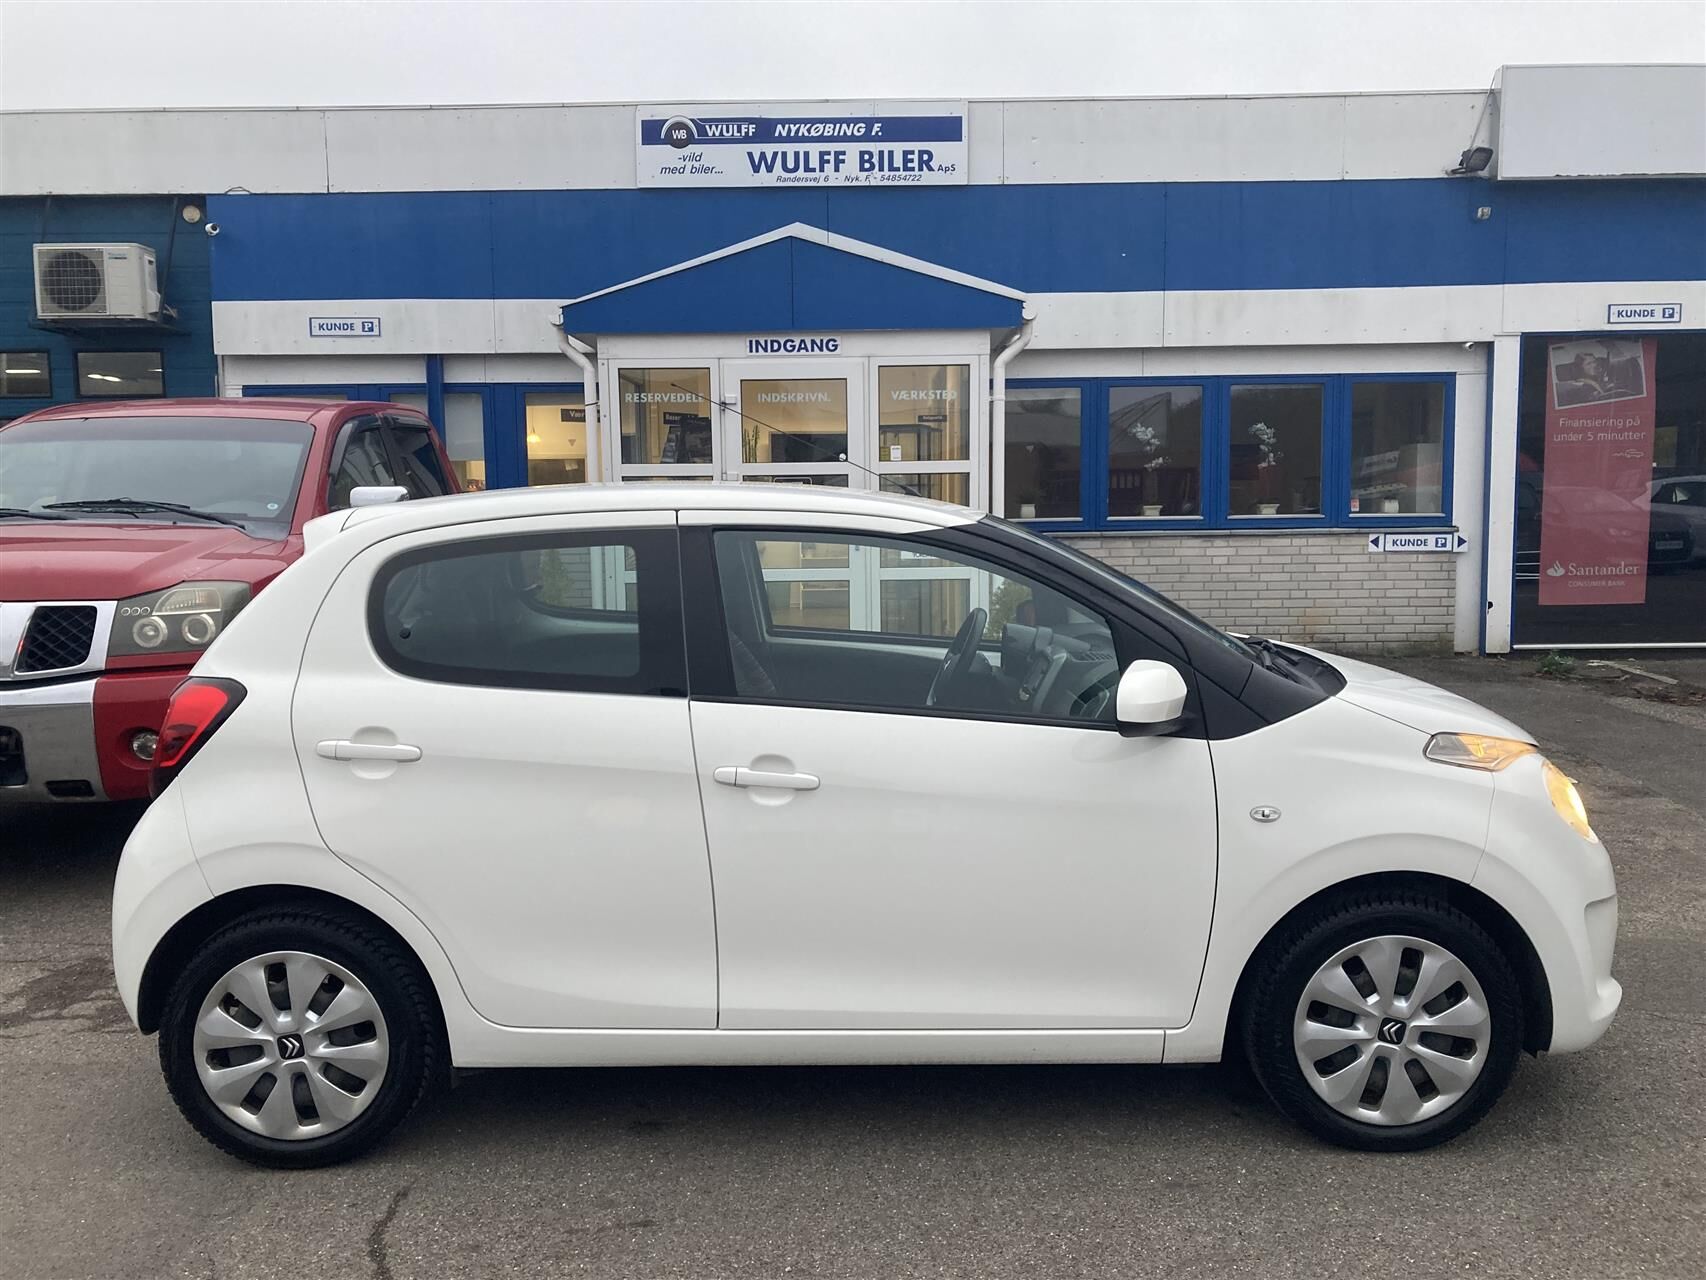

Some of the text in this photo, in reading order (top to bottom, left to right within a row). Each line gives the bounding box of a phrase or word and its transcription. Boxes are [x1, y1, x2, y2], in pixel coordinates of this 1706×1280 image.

[672, 129, 687, 140] WB
[705, 124, 756, 137] WULFF
[774, 123, 882, 137] NYKØBING F.
[677, 152, 703, 163] -vild
[746, 149, 956, 174] WULFF BILER ApS
[660, 164, 723, 175] med biler...
[775, 175, 821, 184] Randersvej
[823, 175, 830, 183] 6
[844, 175, 862, 183] Nyk.
[879, 174, 922, 182] 54854722
[1617, 309, 1656, 318] KUNDE
[318, 322, 355, 331] KUNDE
[748, 338, 839, 353] INDGANG
[890, 389, 957, 400] VÆRKSTED
[1559, 416, 1641, 429] Finansiering på
[1553, 431, 1646, 441] under 5 minutter
[1392, 538, 1429, 547] KUNDE
[1568, 561, 1639, 576] Santander
